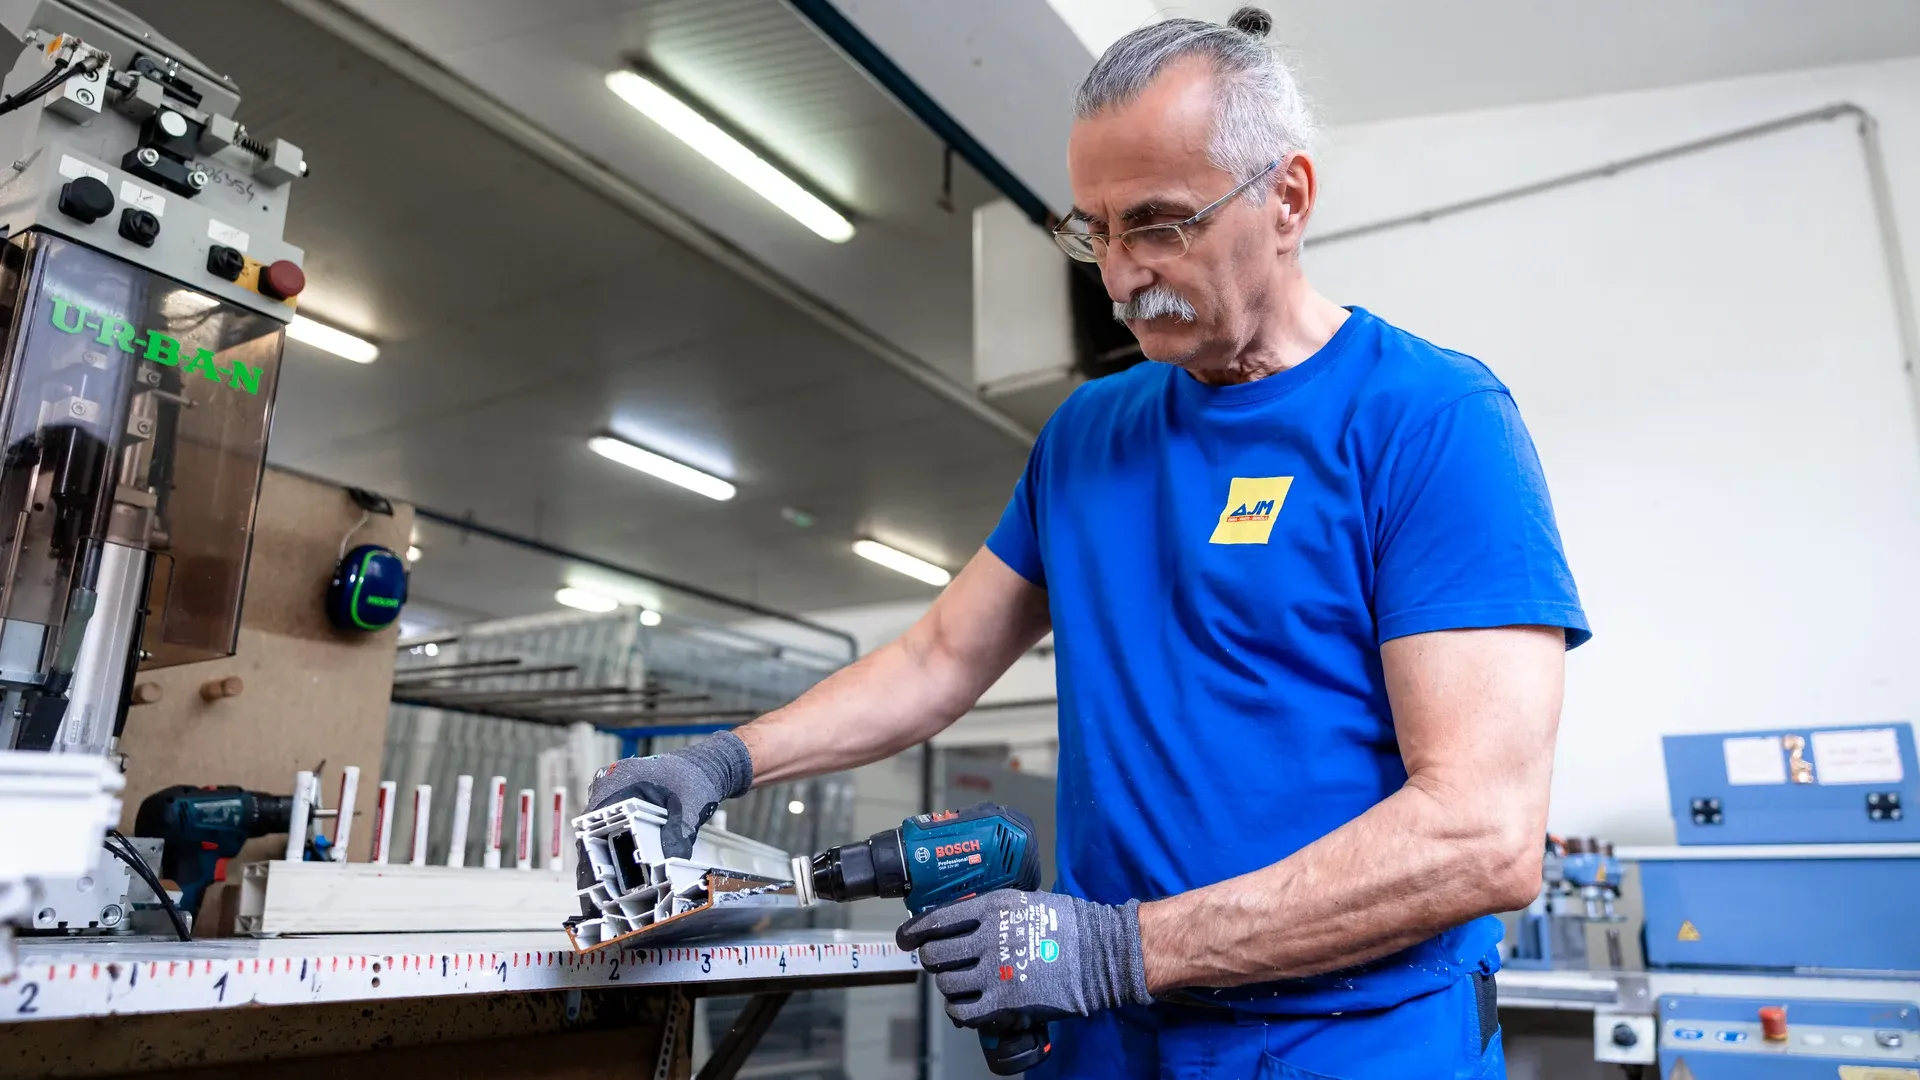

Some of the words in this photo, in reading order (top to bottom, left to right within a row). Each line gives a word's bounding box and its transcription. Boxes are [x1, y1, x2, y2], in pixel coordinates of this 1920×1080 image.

[1230, 499, 1275, 516] AJM
[935, 840, 980, 858] BOSCH
[937, 856, 968, 867] Professional
[17, 982, 39, 1013] 2
[213, 971, 229, 1002] 1
[495, 961, 507, 982] 1
[608, 958, 620, 981] 2
[701, 953, 712, 974] 3
[778, 951, 787, 973] 4
[851, 950, 860, 969] 5
[910, 951, 918, 965] 6
